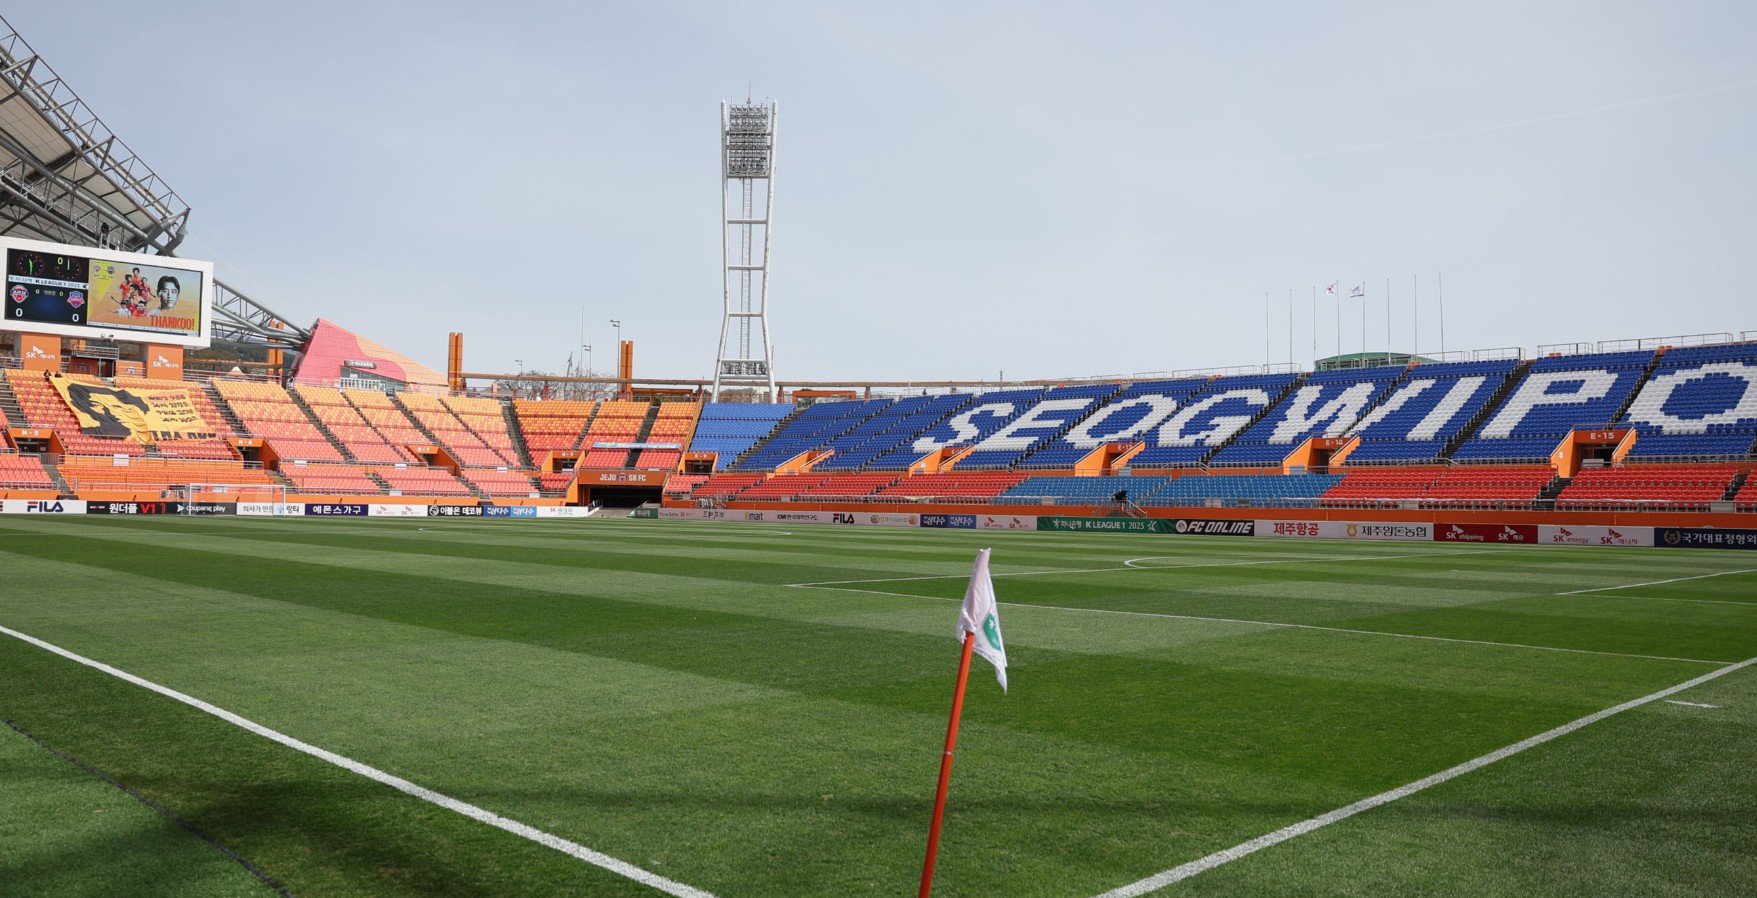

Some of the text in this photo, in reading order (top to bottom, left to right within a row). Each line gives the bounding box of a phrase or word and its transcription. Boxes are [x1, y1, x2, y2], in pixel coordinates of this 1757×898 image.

[16, 308, 23, 317] 0
[72, 313, 79, 322] 0
[150, 315, 194, 330] THANKOO!
[27, 501, 64, 512] FILA
[109, 503, 137, 514] 원더풀
[313, 505, 361, 514] 에몬스가구
[745, 512, 763, 520] emart
[833, 513, 854, 524] FILA
[1187, 520, 1205, 532] FC
[1205, 521, 1254, 533] ONLINE
[1273, 522, 1319, 536] 제주항공
[1361, 525, 1427, 538] 제주양돈농협
[1459, 533, 1484, 541] shipping
[1601, 536, 1612, 544] SK
